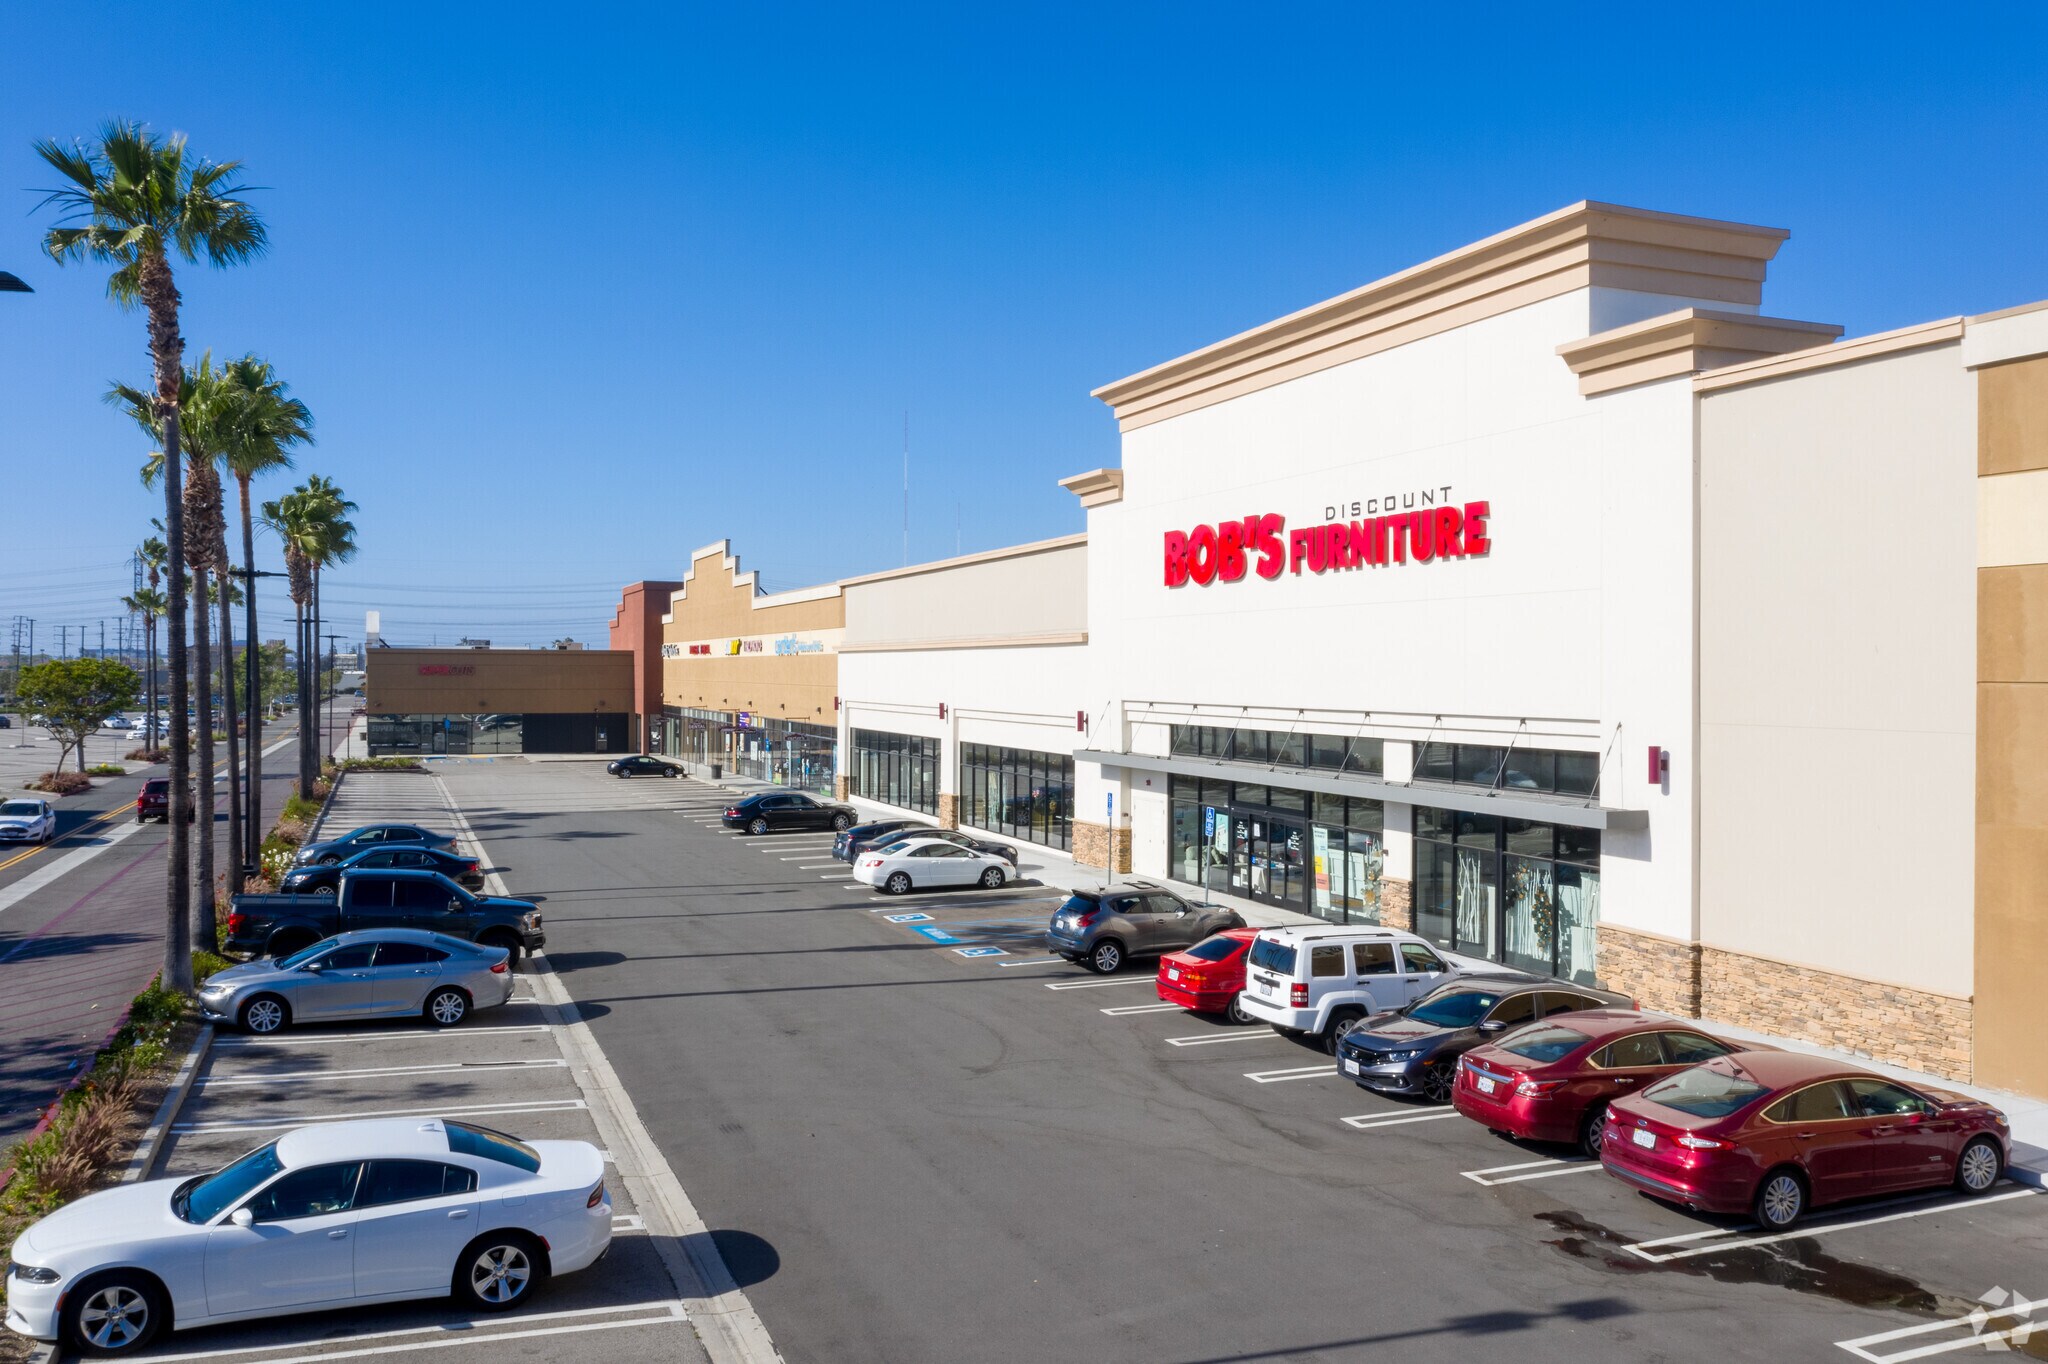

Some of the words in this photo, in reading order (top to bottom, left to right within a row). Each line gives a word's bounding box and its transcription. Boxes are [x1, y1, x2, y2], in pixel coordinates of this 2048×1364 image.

[1325, 486, 1453, 521] DISCOUNT
[1164, 512, 1287, 589] BOB'S
[1289, 500, 1491, 576] FURNITURE
